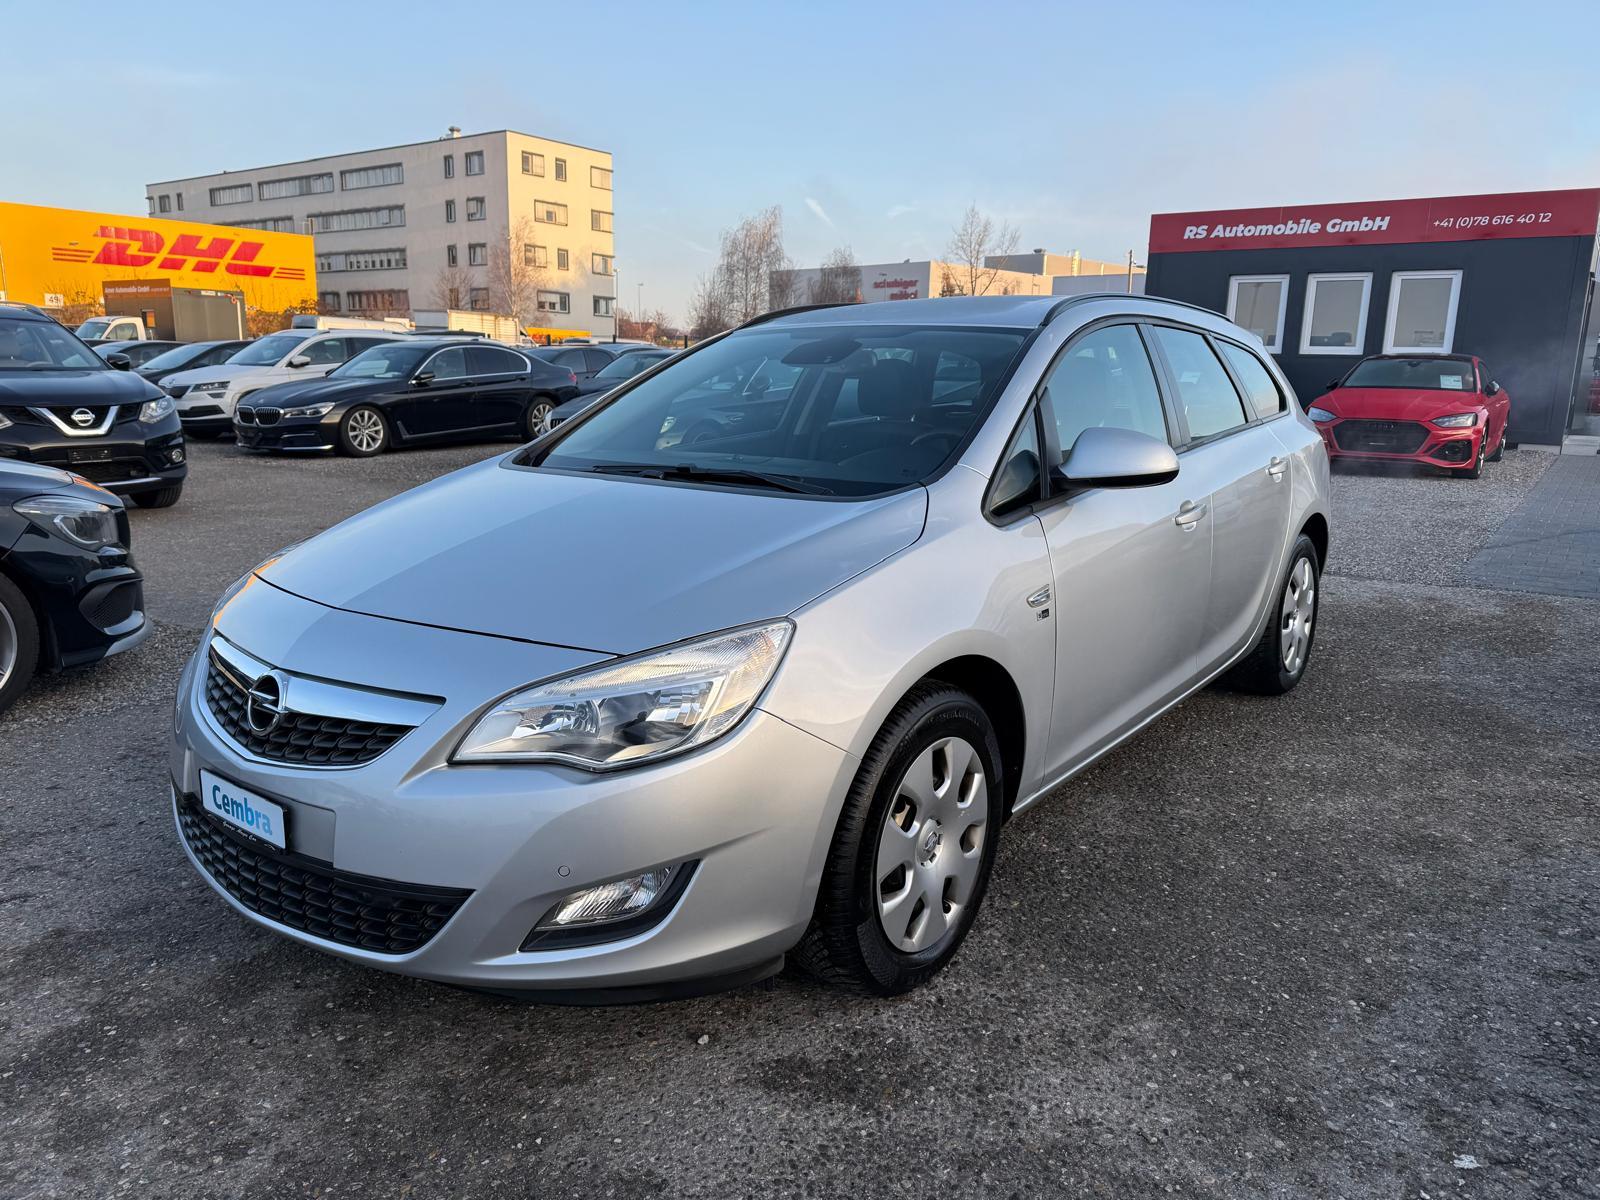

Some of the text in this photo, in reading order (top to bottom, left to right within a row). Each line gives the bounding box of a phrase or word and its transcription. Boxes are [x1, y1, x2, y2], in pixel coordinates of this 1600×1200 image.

[1183, 215, 1391, 240] RS Automobile GmbH
[1433, 212, 1552, 229] +41 (0)78 616 40 12
[92, 225, 276, 278] DHL
[212, 784, 273, 836] Cembra
